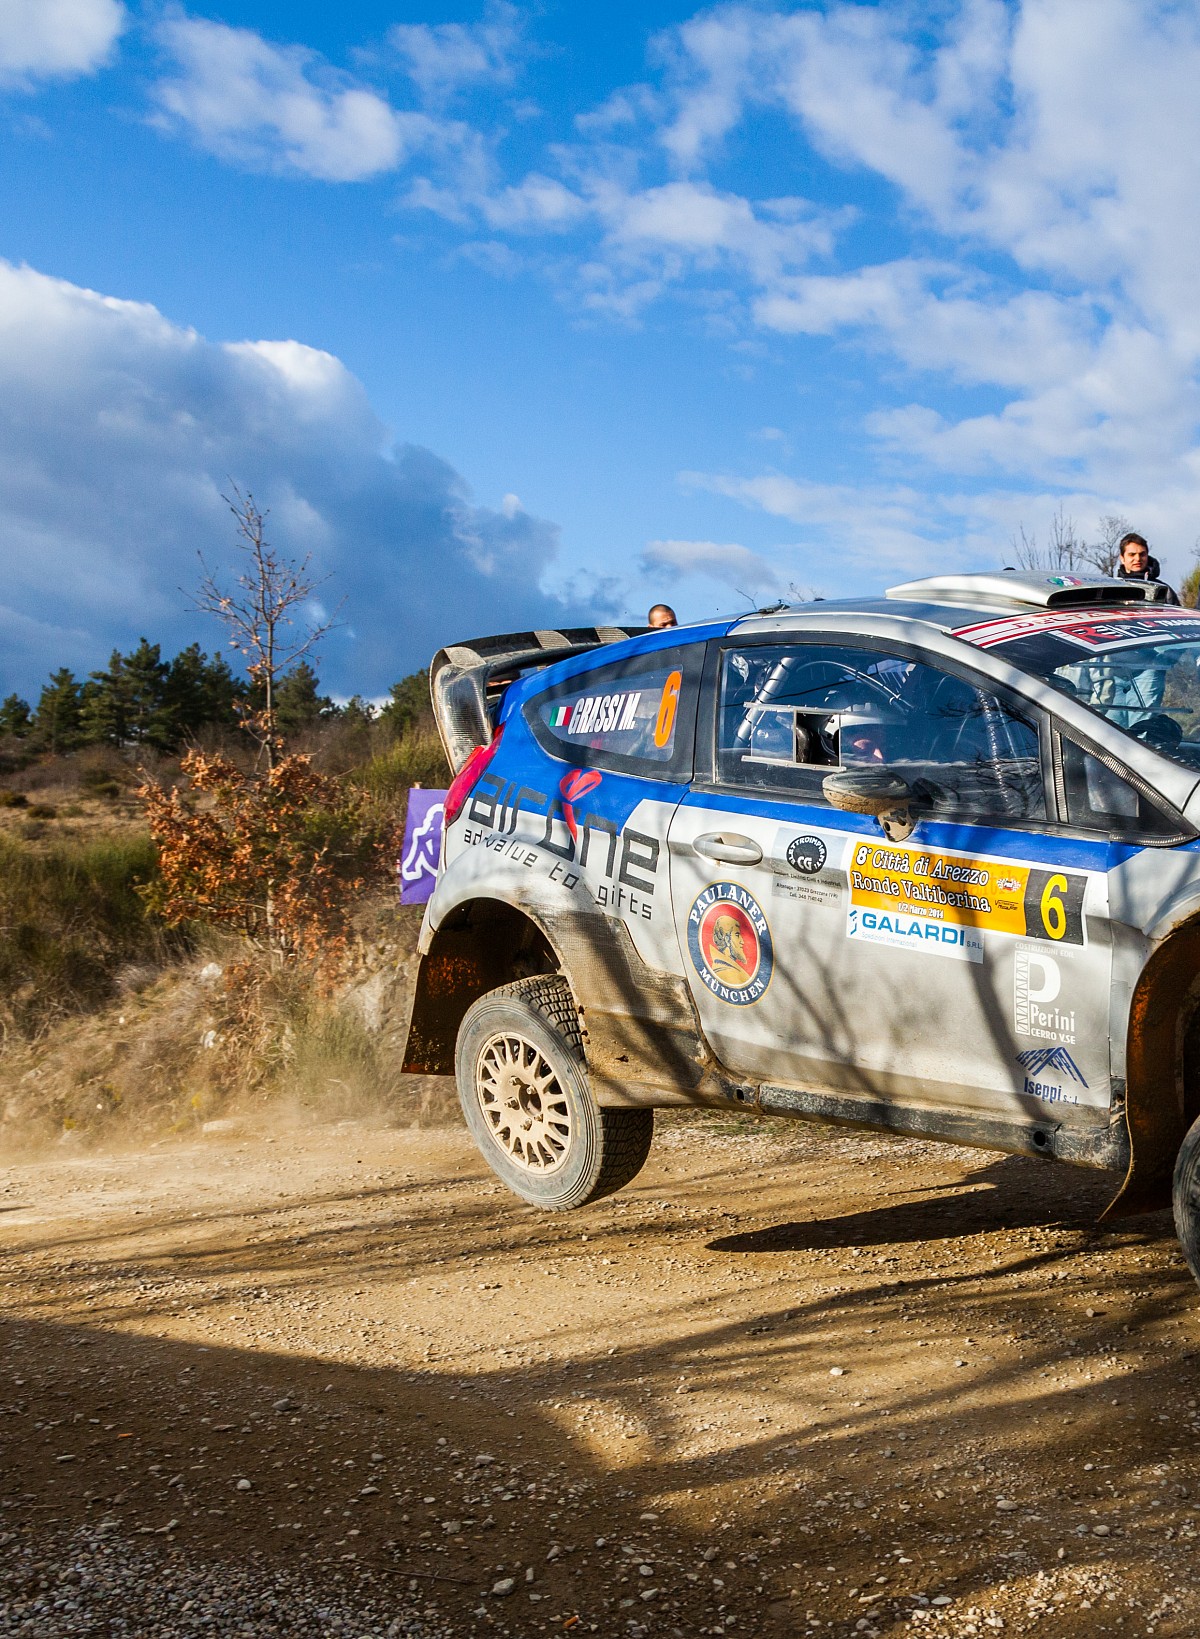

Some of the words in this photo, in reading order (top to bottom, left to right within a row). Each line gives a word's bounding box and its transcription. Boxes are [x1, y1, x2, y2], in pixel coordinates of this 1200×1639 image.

[568, 694, 626, 734] GRASSI
[617, 692, 642, 731] M.
[654, 671, 683, 748] 6
[797, 855, 812, 871] CG
[872, 849, 910, 873] Città
[913, 857, 930, 876] di
[930, 859, 989, 886] Arezzo
[548, 861, 580, 890] to
[595, 885, 652, 921] gifts
[851, 871, 899, 896] Ronde
[900, 879, 991, 913] Valtiberina
[1040, 873, 1068, 940] 6
[690, 885, 768, 935] PAULANER
[909, 904, 927, 917] Marzo
[928, 907, 945, 919] 2014
[862, 912, 965, 946] GALARDI
[700, 968, 765, 1002] MÜNCHEN
[1030, 1028, 1057, 1040] CERRO
[1031, 1003, 1075, 1032] Perini
[1024, 1076, 1062, 1104] Iseppi
